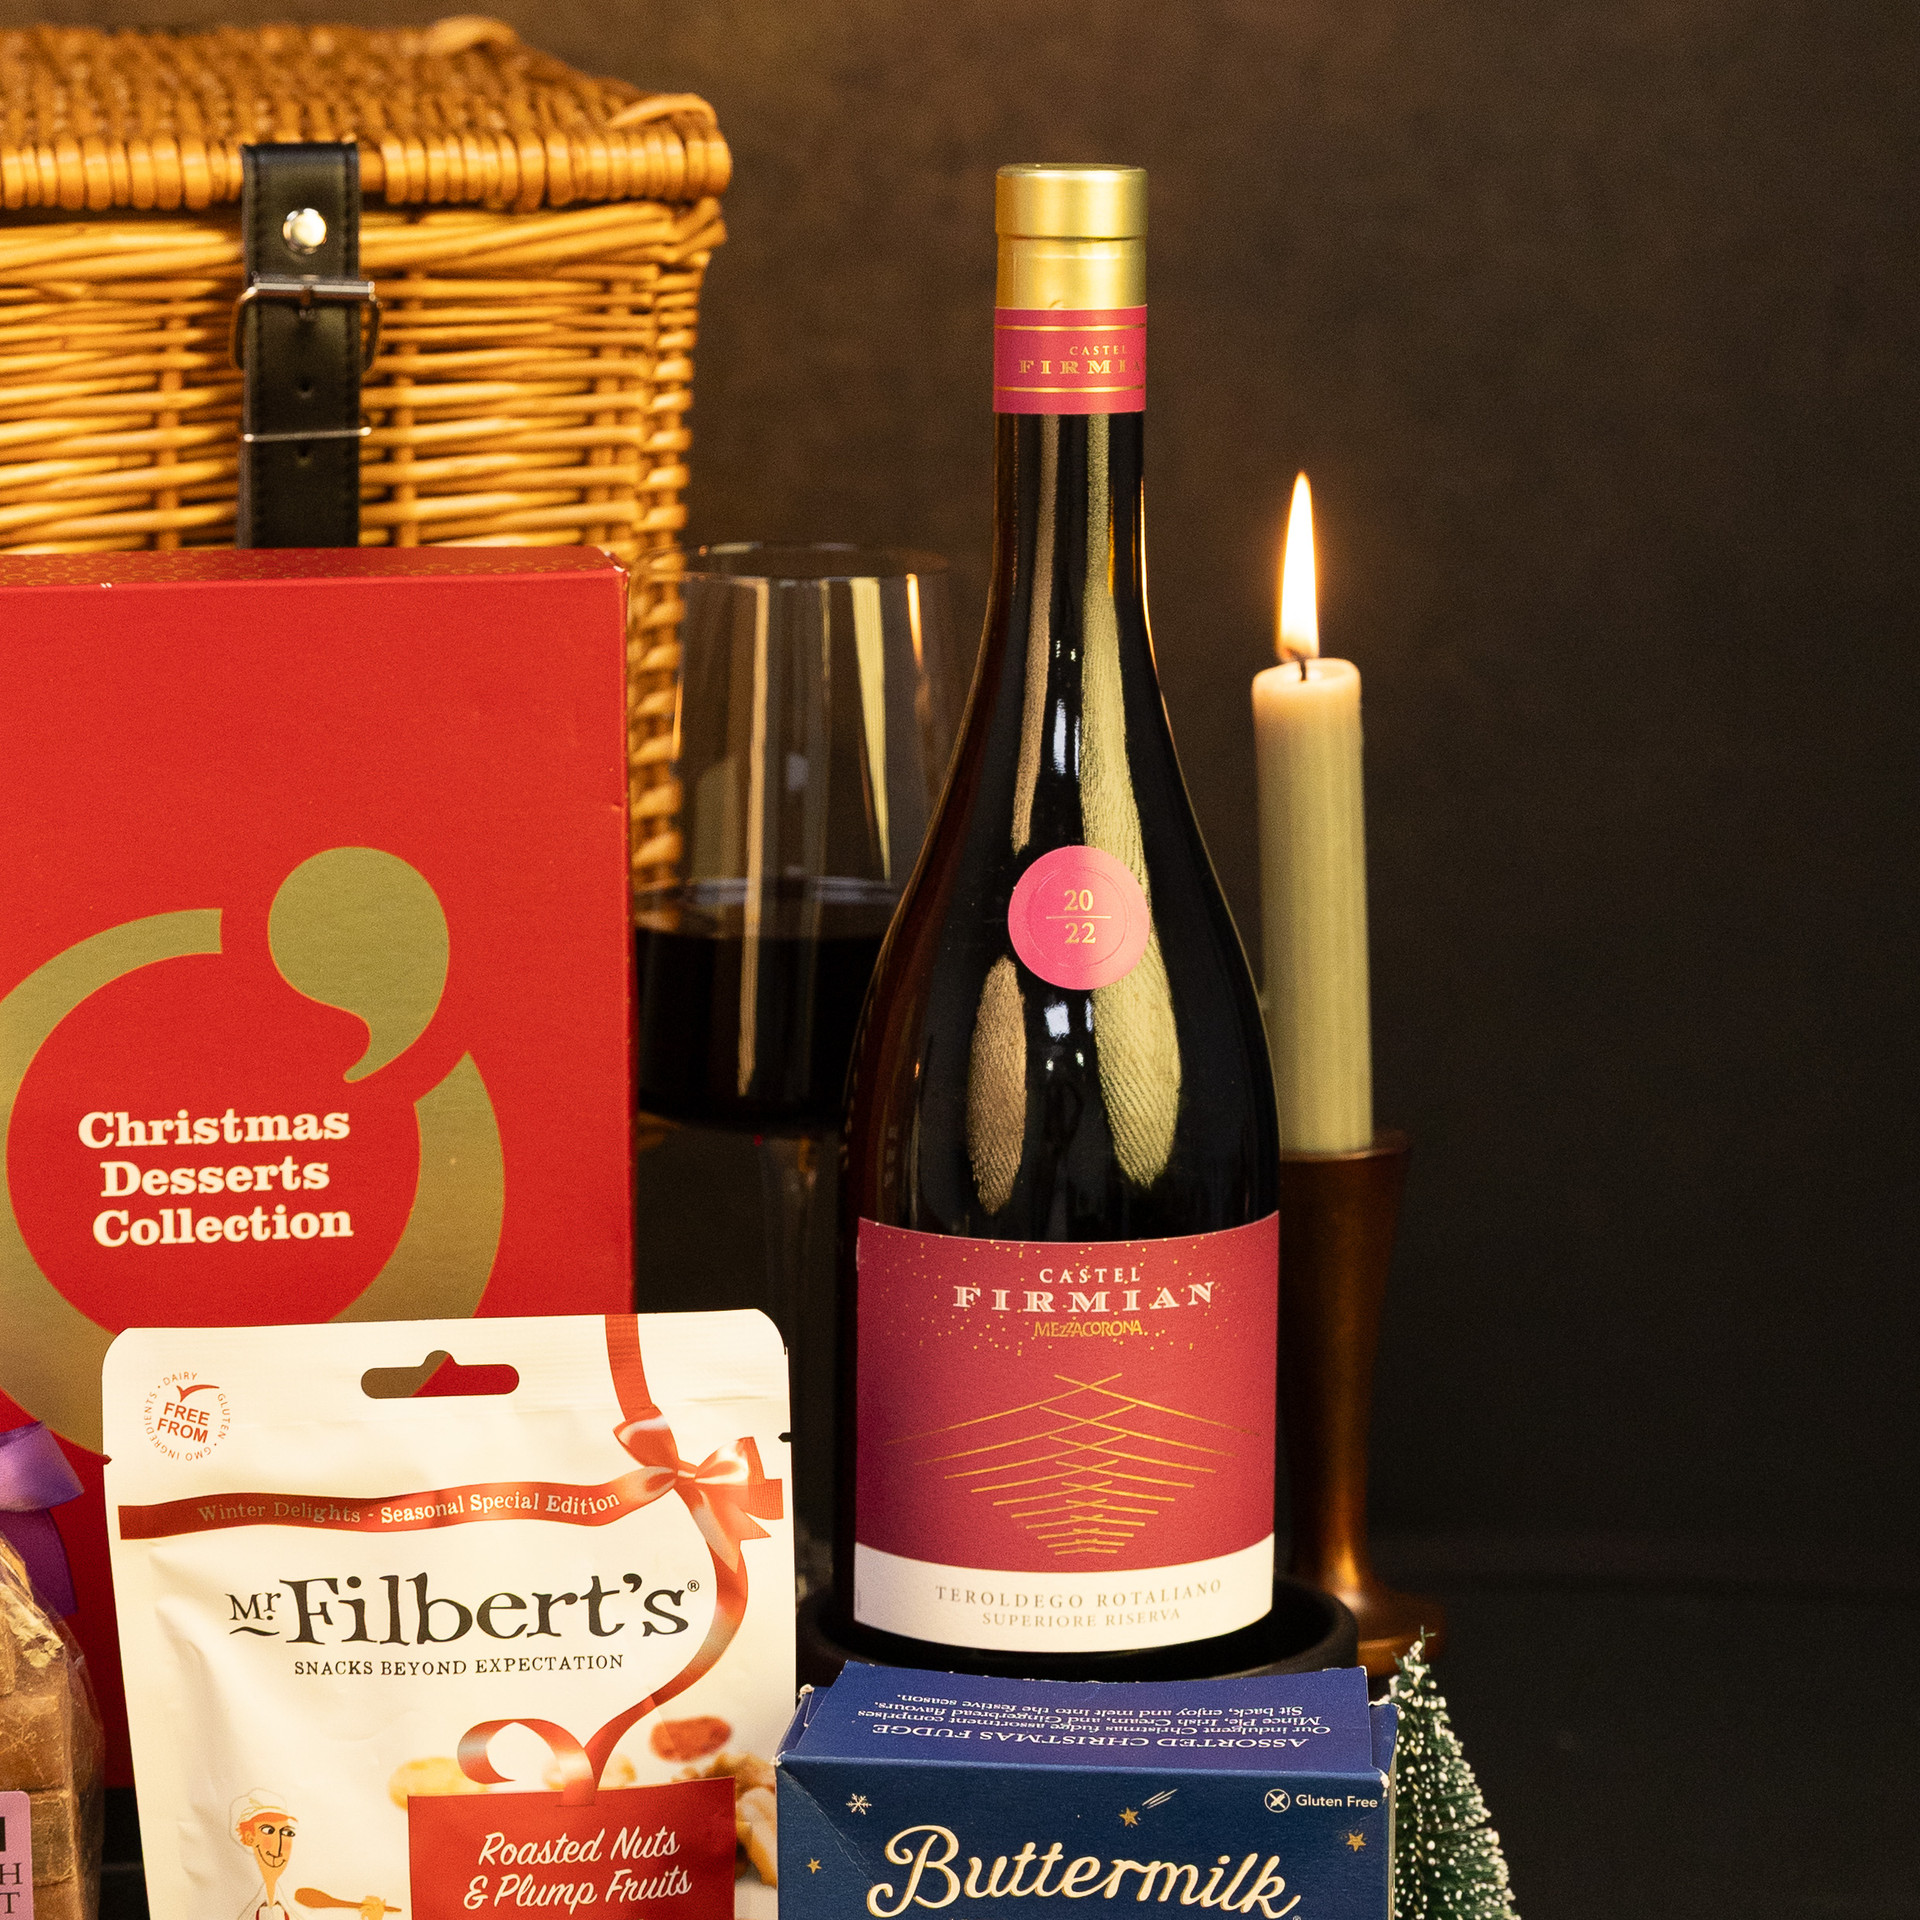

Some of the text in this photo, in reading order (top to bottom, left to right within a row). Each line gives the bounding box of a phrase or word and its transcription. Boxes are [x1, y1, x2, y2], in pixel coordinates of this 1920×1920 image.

[1064, 889, 1094, 912] 20
[1064, 921, 1096, 944] 22
[78, 1108, 350, 1149] Christmas
[100, 1155, 330, 1197] Desserts
[93, 1204, 354, 1247] Collection
[1039, 1267, 1141, 1284] CASTEL
[953, 1282, 1215, 1313] FIRMIAN
[163, 1371, 198, 1386] DAIRY
[144, 1391, 212, 1462] GMO INGREDIENTS
[163, 1402, 210, 1427] FREE
[217, 1393, 231, 1440] GLUTEN
[157, 1417, 208, 1444] FROM
[198, 1502, 266, 1523] Winter
[273, 1501, 361, 1523] Delights
[381, 1494, 464, 1524] Seasonal
[469, 1491, 539, 1513] Special
[546, 1490, 621, 1516] Edition
[935, 1578, 1223, 1609] TEROLDEGO ROTALIANO
[982, 1609, 1181, 1628] SUPERIORE RISERVA
[295, 1654, 624, 1676] SNACKS BEYOND EXPECTATION
[874, 1702, 1322, 1727] Mince Pie, Irish Cream, and Gingerbread flavours.
[897, 1694, 1303, 1717] Sit back, enjoy and melt into the festive season.
[858, 1709, 1331, 1736] Our indulgent Christmas fudge assortment comprises
[872, 1723, 1309, 1748] ASSORTED CHRISTMAS FUDGE
[1296, 1794, 1378, 1808] Gluten Free
[478, 1825, 681, 1866] Roasted Nuts
[866, 1825, 1302, 1919] Buttermilk
[464, 1865, 692, 1915] & Plump Fruits
